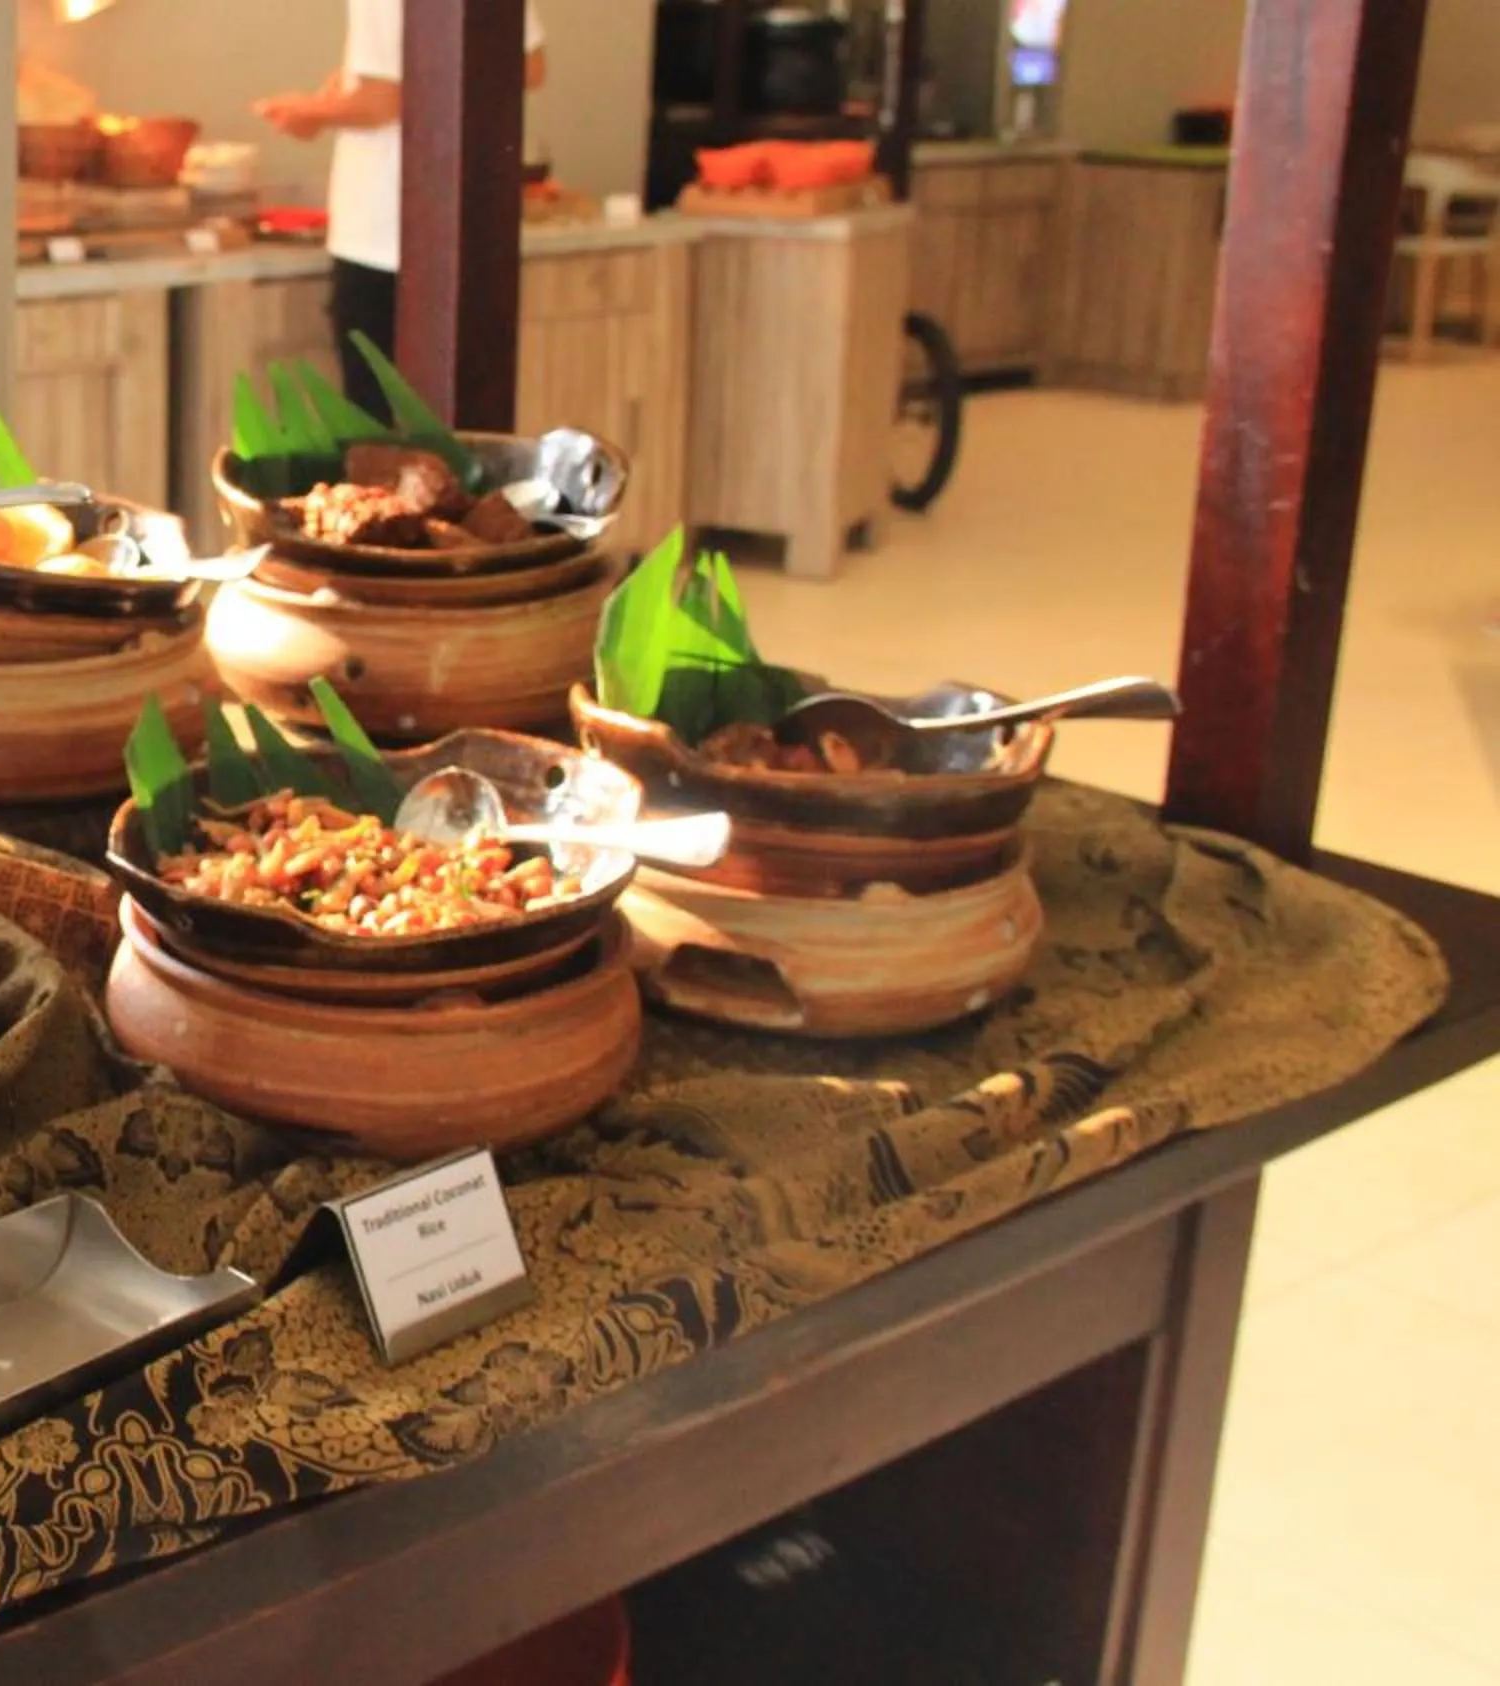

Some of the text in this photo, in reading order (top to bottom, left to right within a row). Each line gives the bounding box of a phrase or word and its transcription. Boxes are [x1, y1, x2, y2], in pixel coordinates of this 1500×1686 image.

[361, 1174, 486, 1233] Traditional Coconut
[416, 1220, 446, 1239] Rice
[416, 1283, 446, 1308] Nasi
